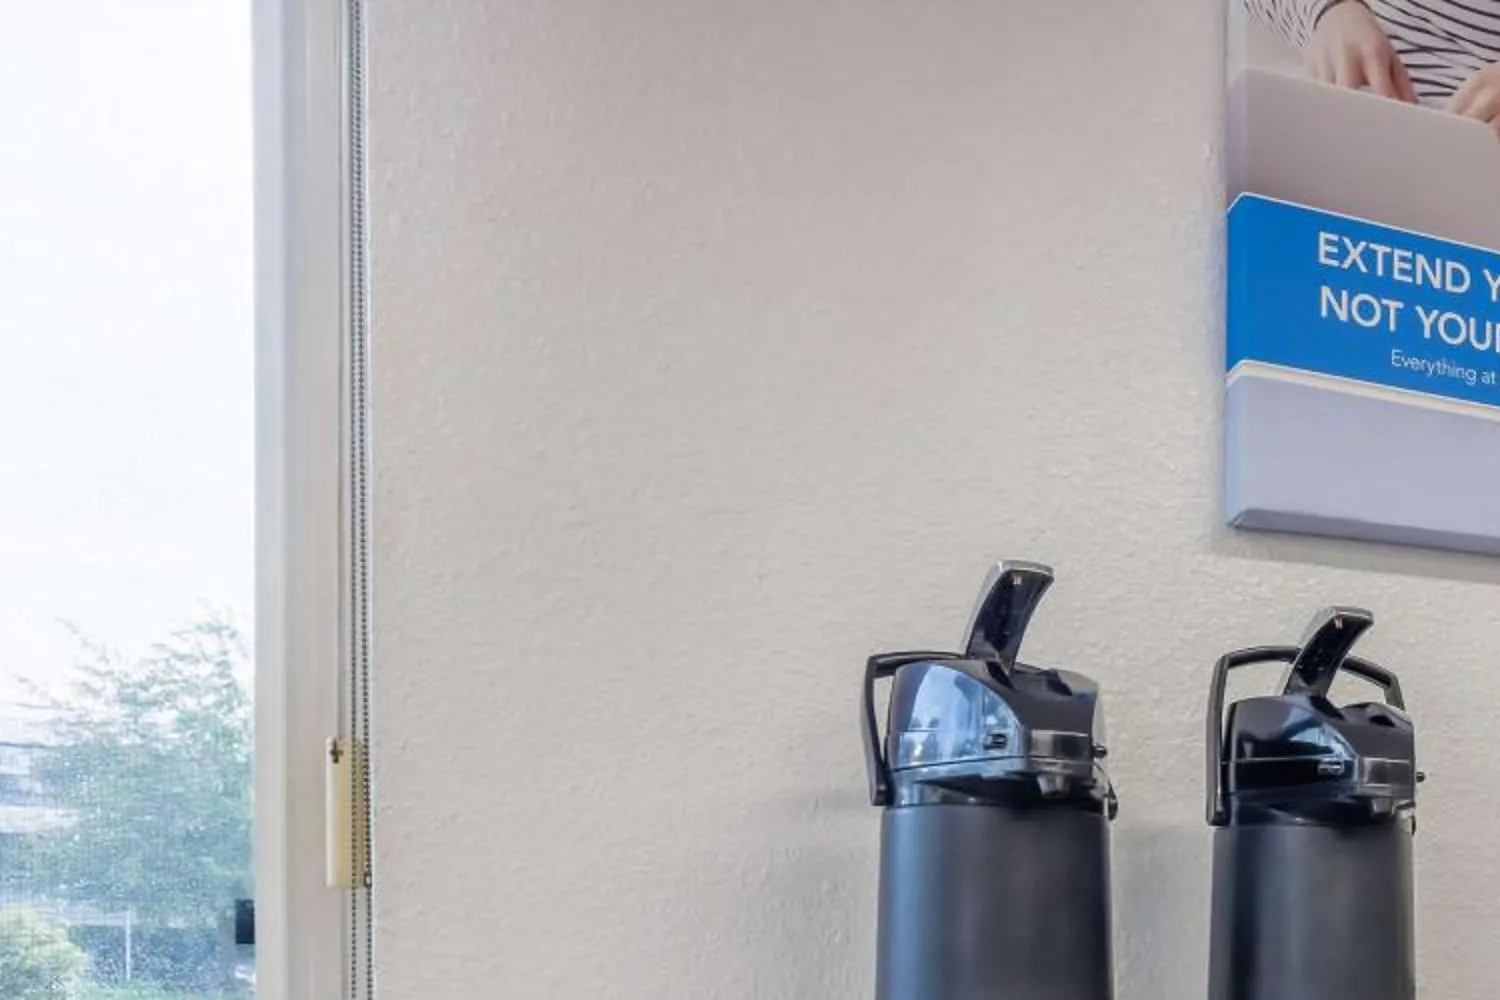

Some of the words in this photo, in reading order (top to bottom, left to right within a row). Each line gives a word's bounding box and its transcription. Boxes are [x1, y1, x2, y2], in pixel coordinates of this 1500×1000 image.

[1318, 231, 1471, 294] EXTEND
[1320, 285, 1404, 332] NOT
[1391, 349, 1477, 386] Everything
[1482, 370, 1496, 385] at
